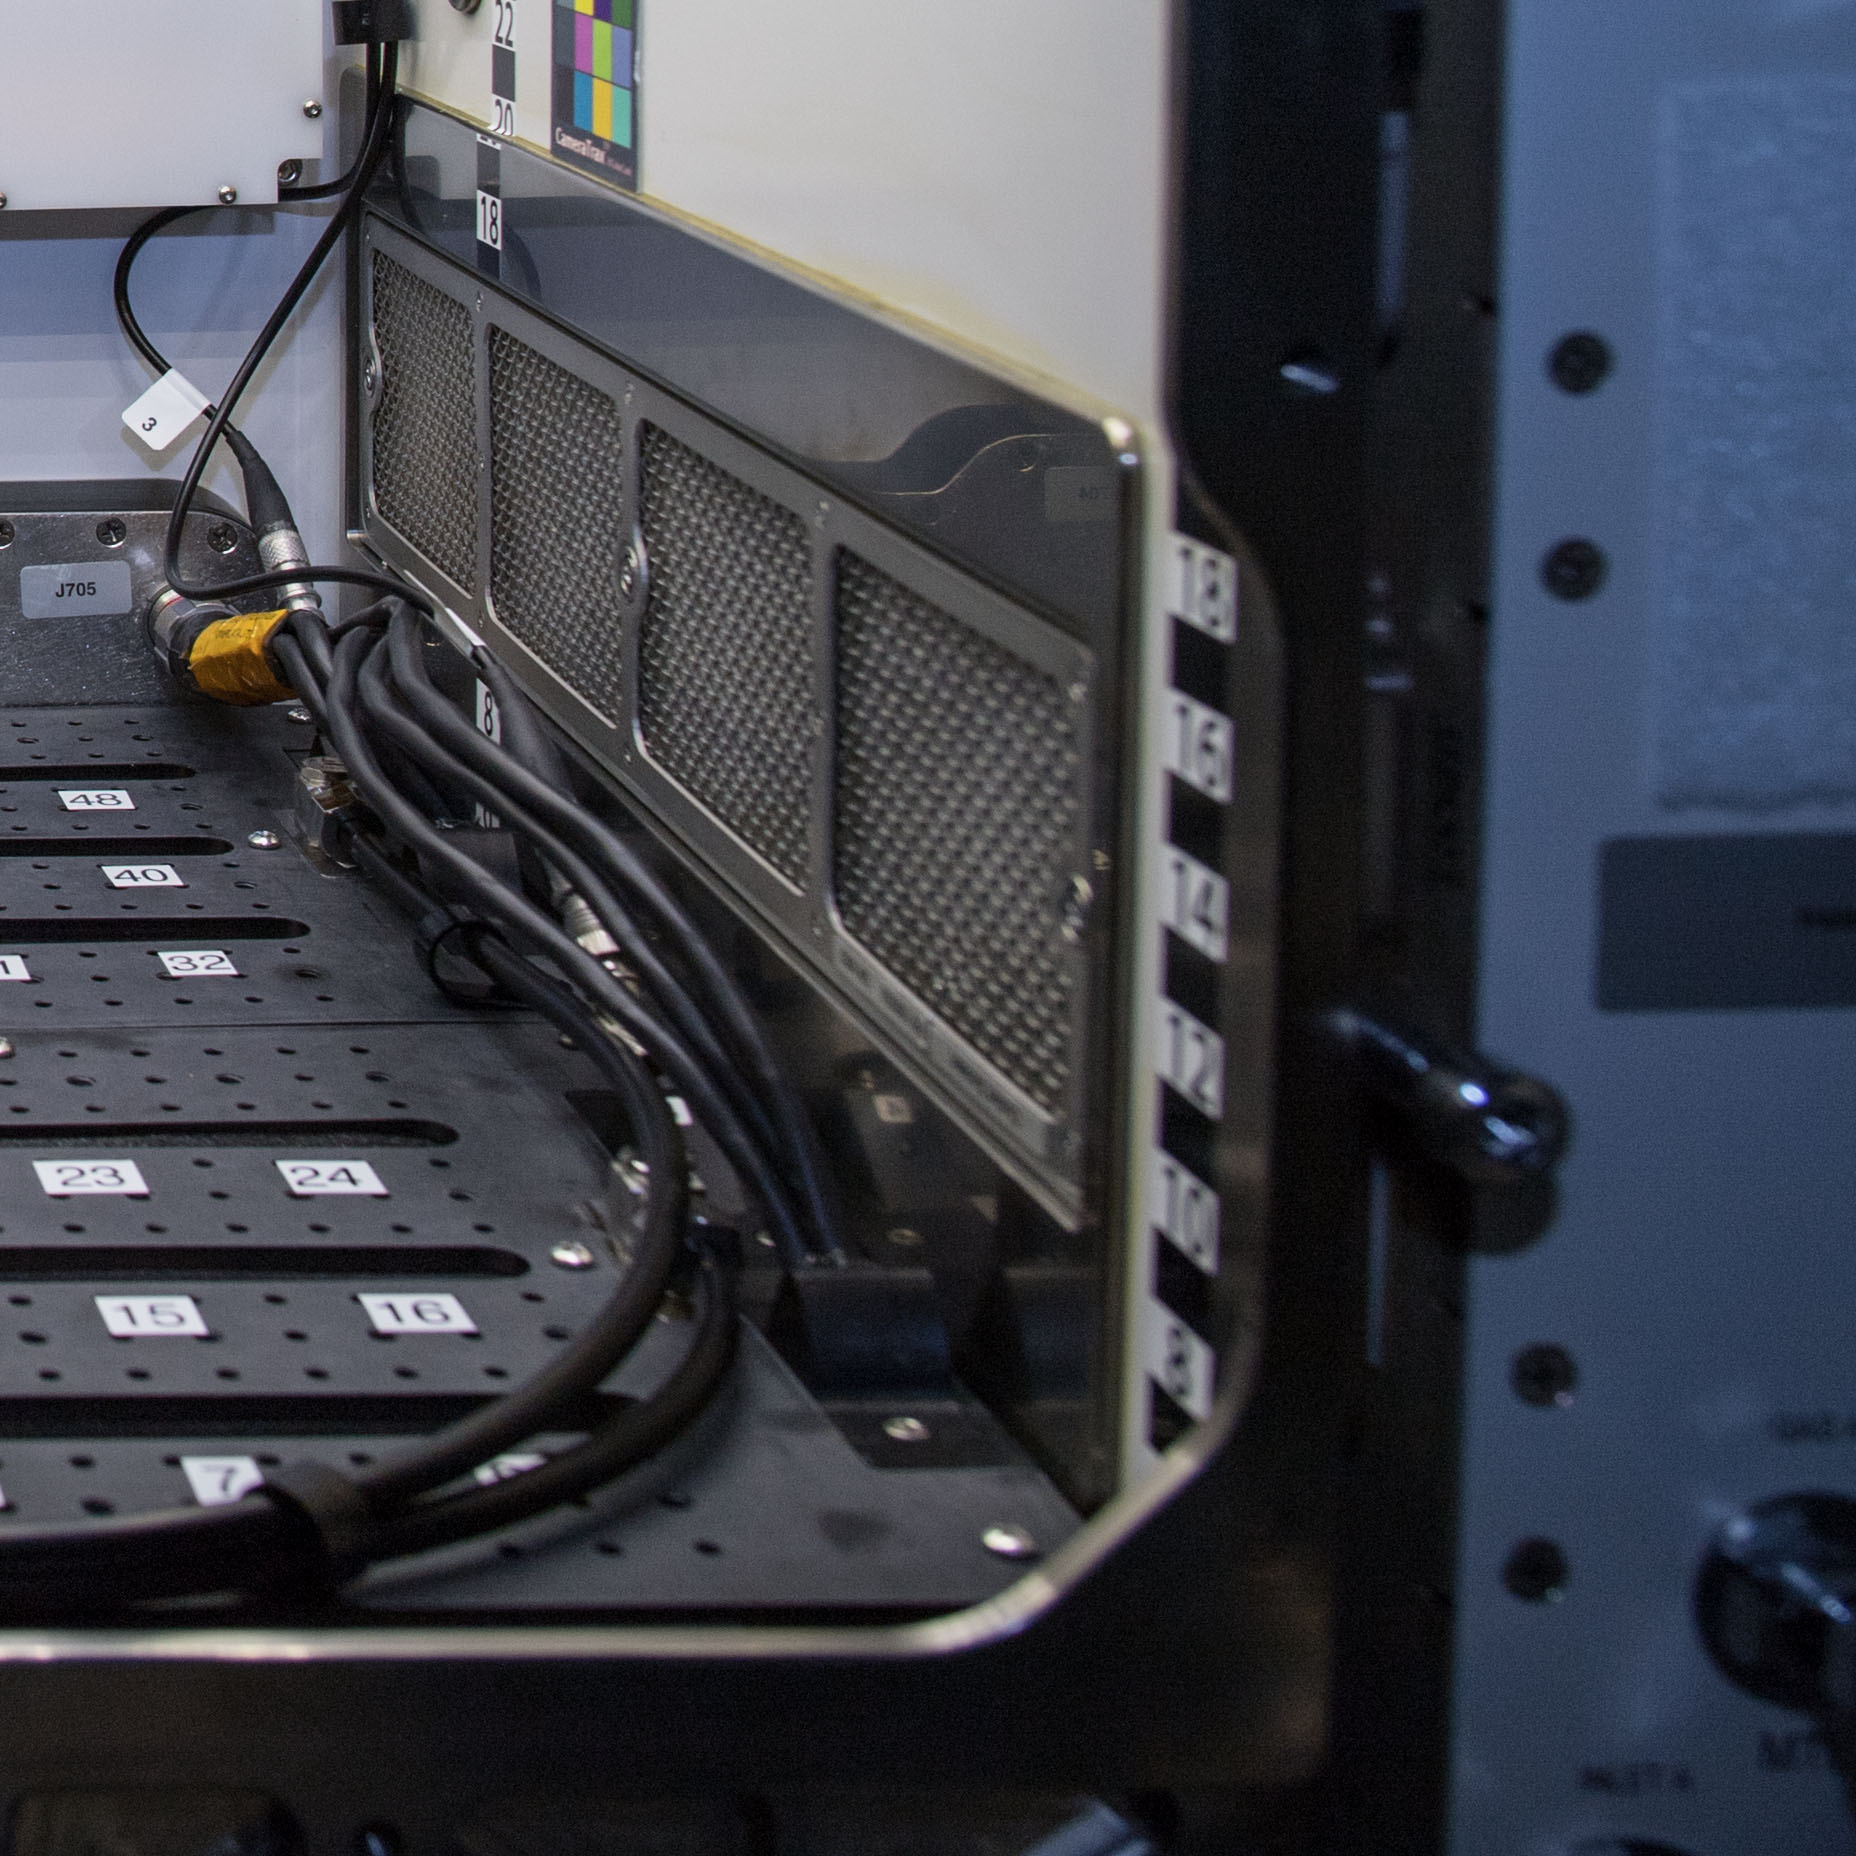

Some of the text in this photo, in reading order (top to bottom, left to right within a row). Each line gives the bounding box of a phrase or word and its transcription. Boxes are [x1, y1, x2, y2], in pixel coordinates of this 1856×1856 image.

[481, 195, 499, 246] 18
[140, 415, 157, 433] 3
[53, 580, 98, 600] J705
[69, 793, 123, 808] 48
[114, 868, 170, 883] 40
[171, 954, 227, 973] 32
[60, 1165, 127, 1187] 23
[290, 1166, 360, 1188] 24
[122, 1304, 186, 1327] 15
[385, 1301, 451, 1325] 16
[200, 1463, 243, 1495] 7
